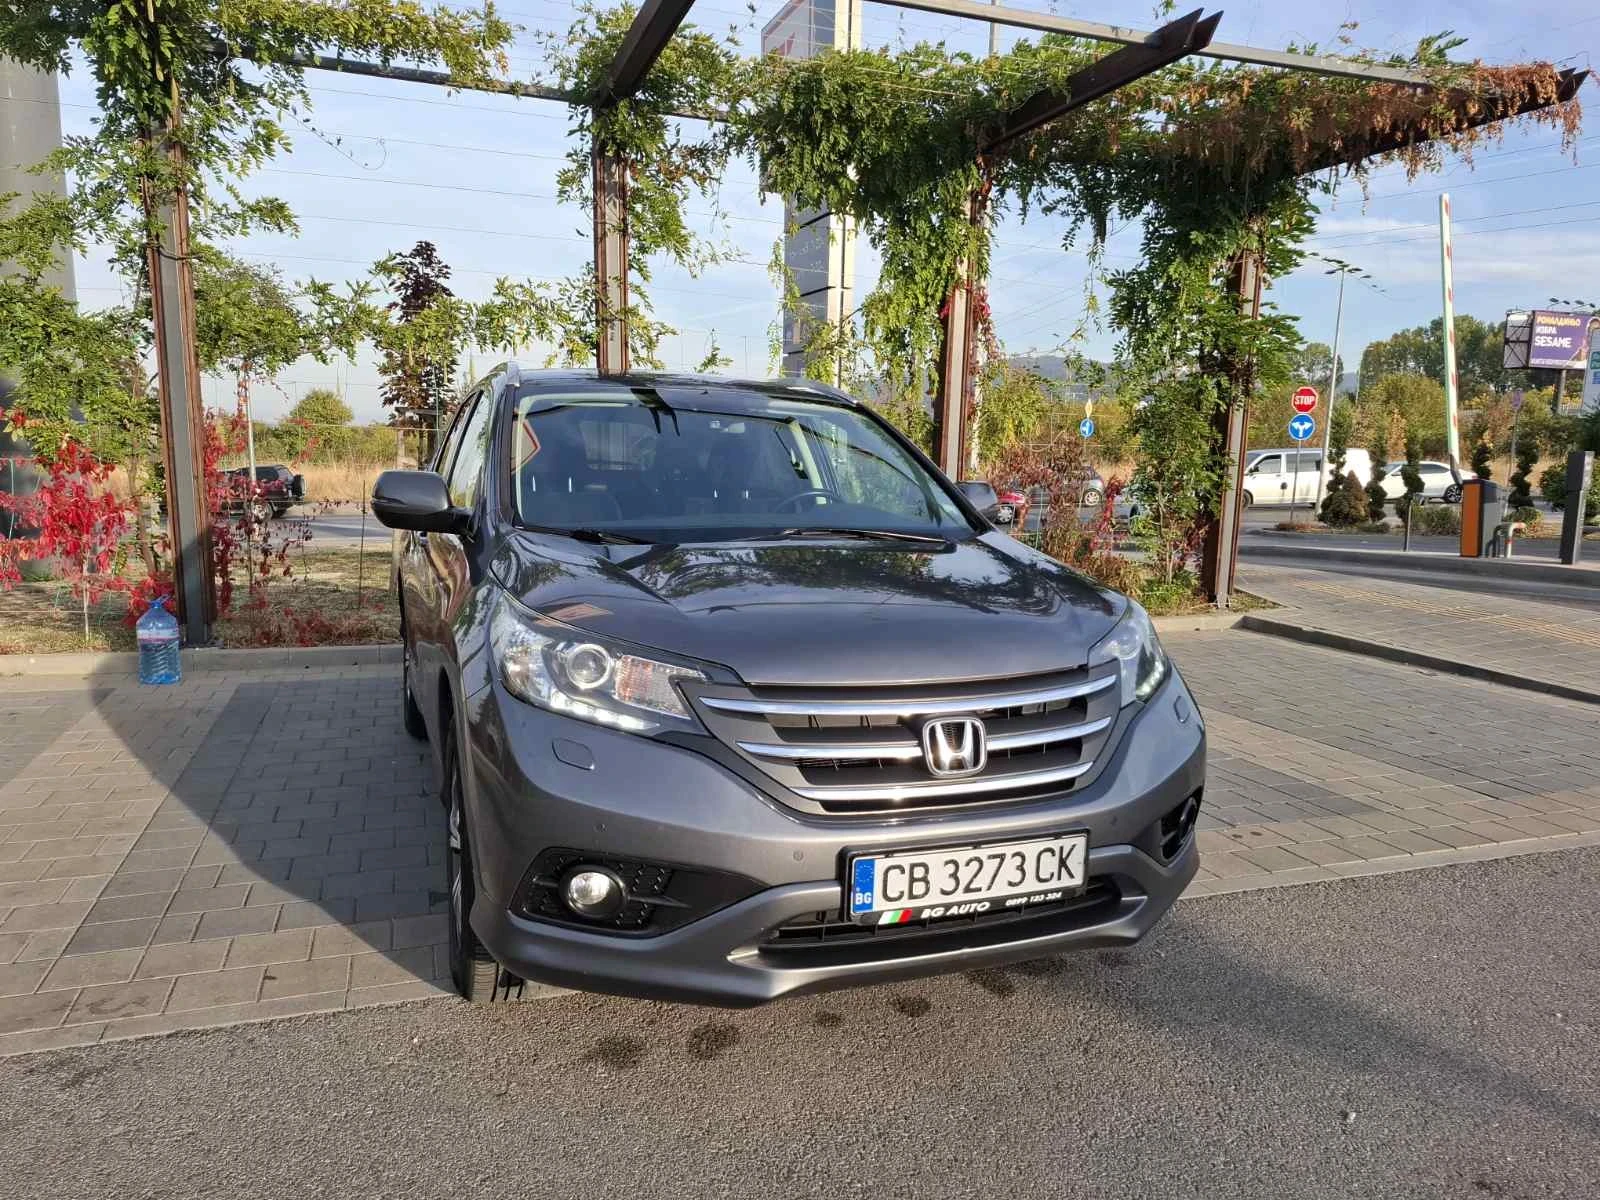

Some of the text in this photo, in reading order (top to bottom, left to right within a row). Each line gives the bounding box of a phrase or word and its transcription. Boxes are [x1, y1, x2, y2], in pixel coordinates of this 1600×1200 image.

[1534, 336, 1573, 348] SESAME
[1294, 395, 1315, 405] STOP
[881, 843, 1077, 903] CB 3273 CK
[855, 892, 872, 905] BG
[920, 907, 946, 919] BG
[946, 901, 991, 917] AUTO
